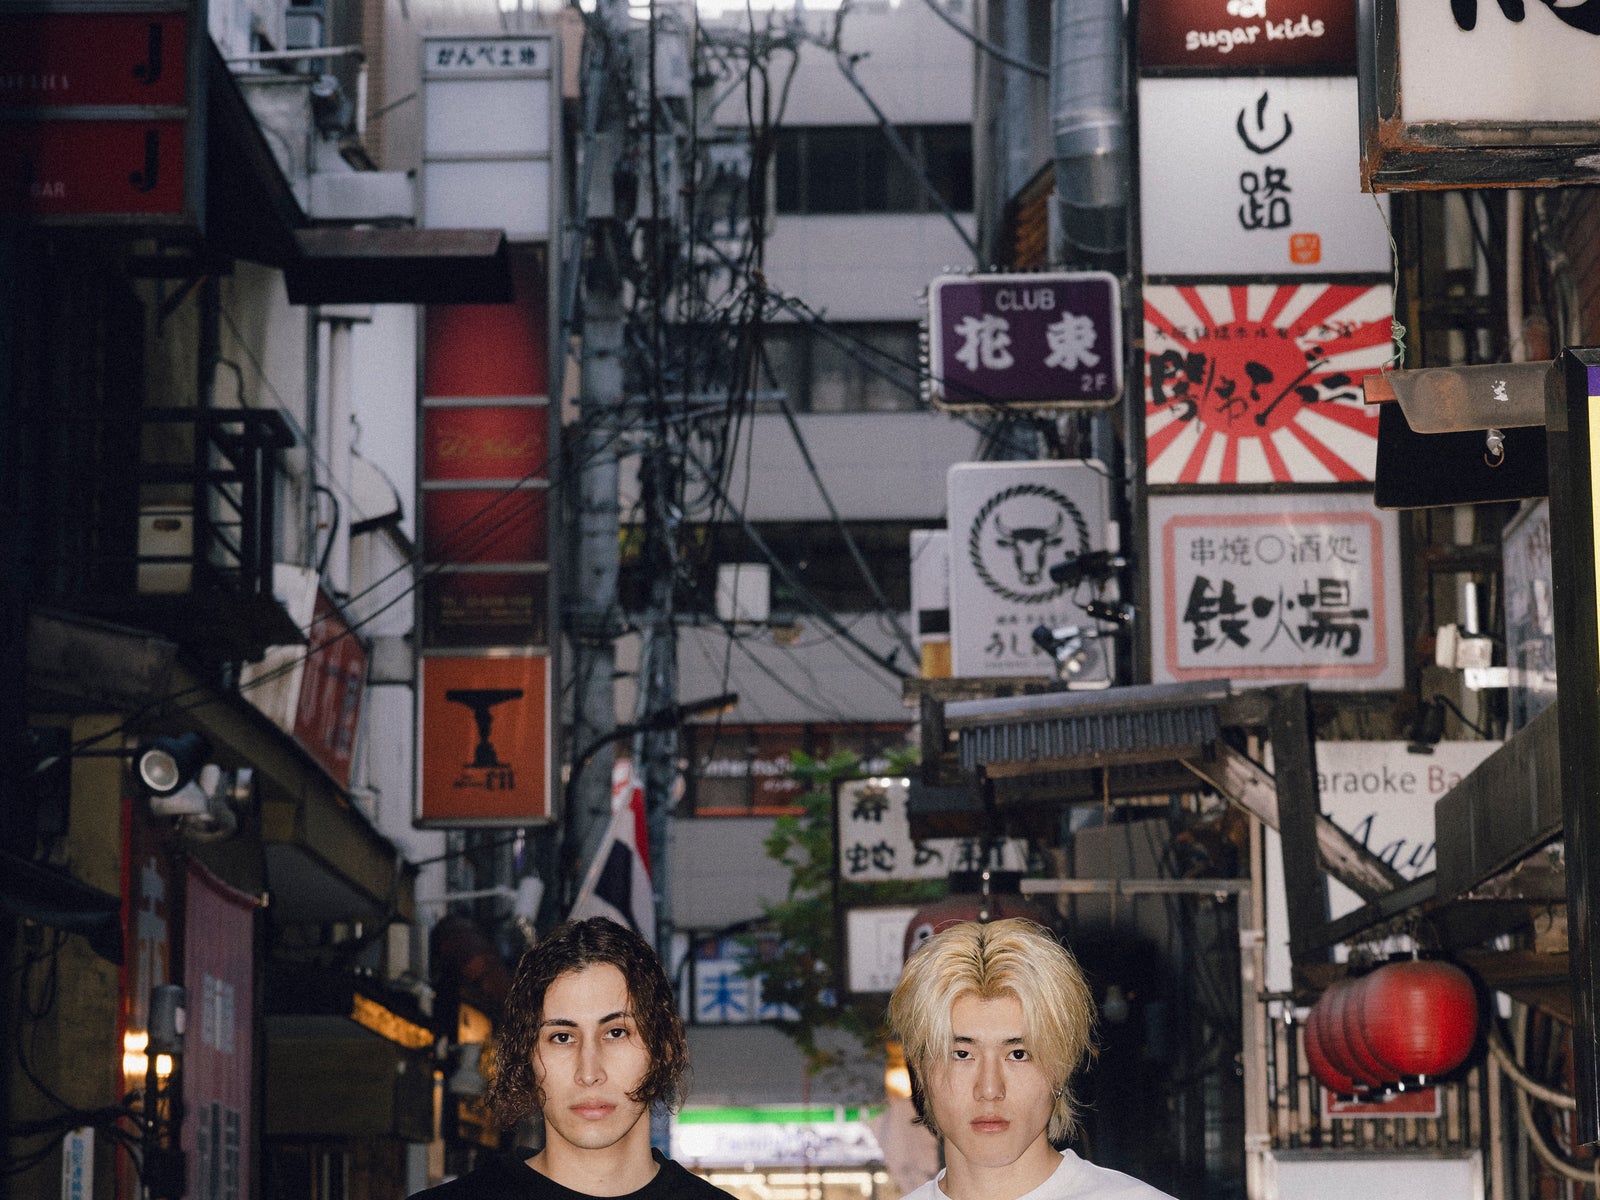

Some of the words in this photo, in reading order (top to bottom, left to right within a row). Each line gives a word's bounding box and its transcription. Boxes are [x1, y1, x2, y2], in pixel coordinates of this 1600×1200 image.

[1185, 25, 1261, 54] sugar
[1265, 13, 1326, 41] kids
[1236, 88, 1293, 231] 山路
[995, 288, 1056, 312] CLUB
[1080, 372, 1108, 393] 2F
[1183, 574, 1370, 657] 鉄火場
[1316, 765, 1417, 794] araoke
[1428, 764, 1464, 794] Ba
